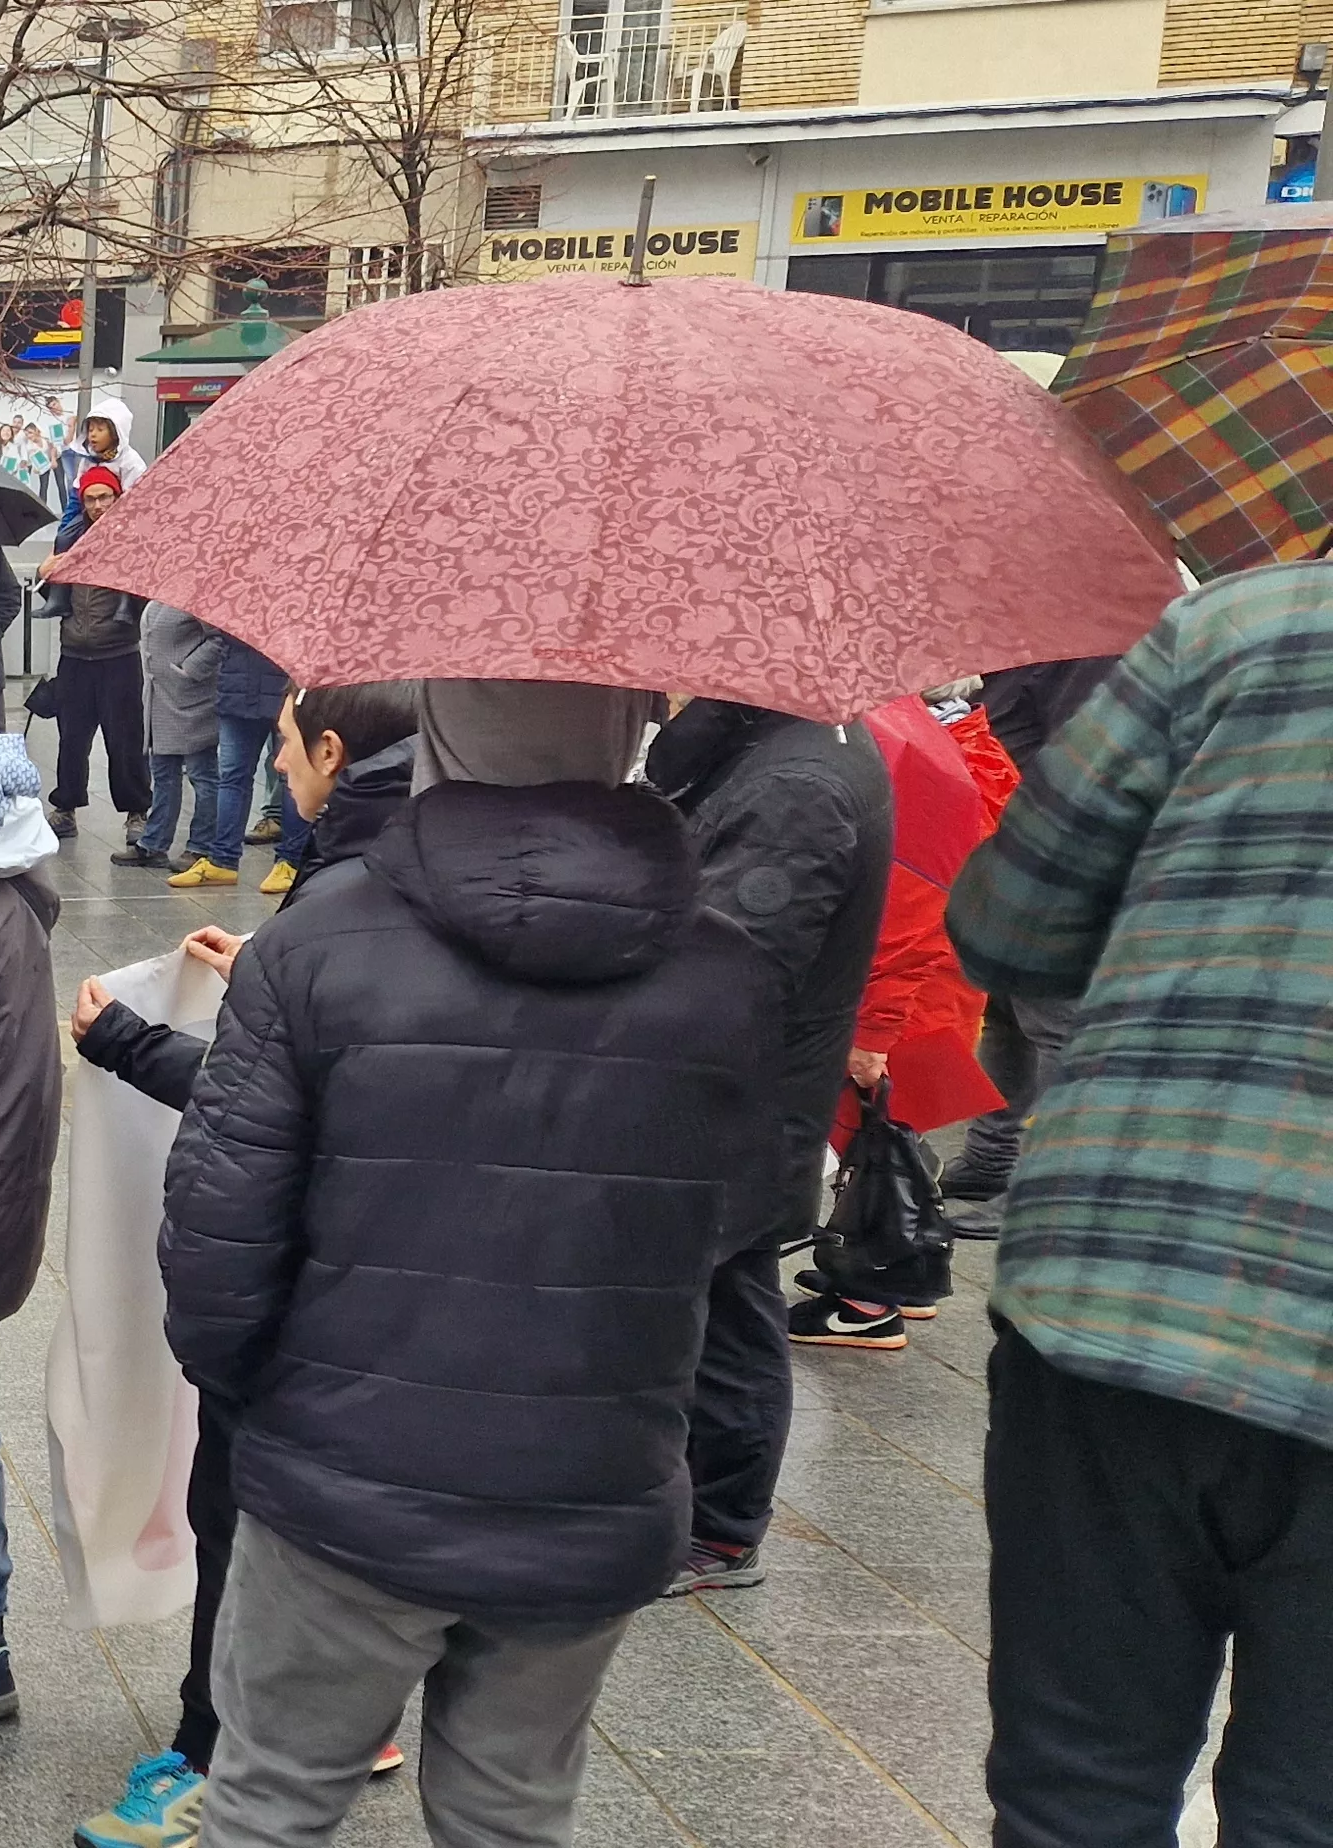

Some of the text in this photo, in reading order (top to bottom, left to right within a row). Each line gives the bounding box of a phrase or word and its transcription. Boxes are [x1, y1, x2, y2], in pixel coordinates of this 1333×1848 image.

[864, 182, 1123, 215] MOBILE HOUSE
[922, 210, 1058, 224] VENTA REPARACIÓN
[491, 235, 614, 262] MOBILE
[547, 258, 677, 274] VENTA REPACIÓN
